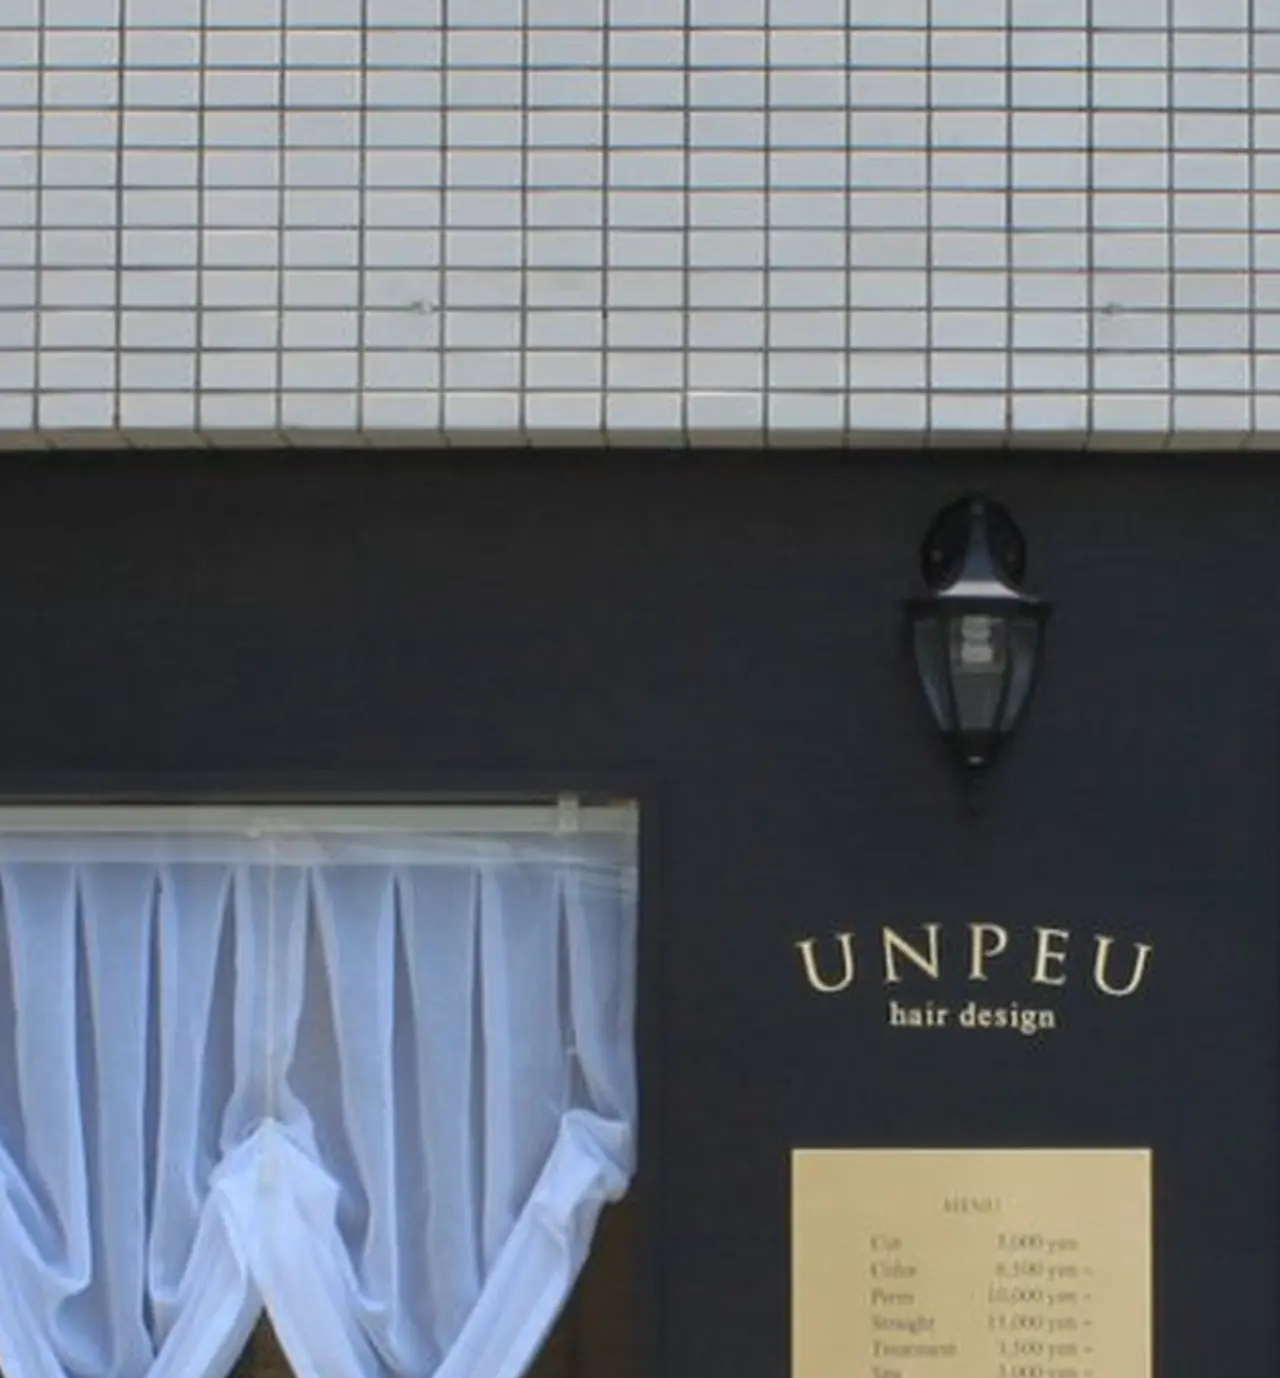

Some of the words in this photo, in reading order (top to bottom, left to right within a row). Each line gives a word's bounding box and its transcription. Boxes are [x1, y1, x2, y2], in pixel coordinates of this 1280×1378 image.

[795, 922, 1153, 997] UNPEU
[888, 1001, 948, 1027] hair
[959, 1001, 1056, 1036] design
[941, 1197, 1002, 1214] MENU
[870, 1260, 917, 1278] Color
